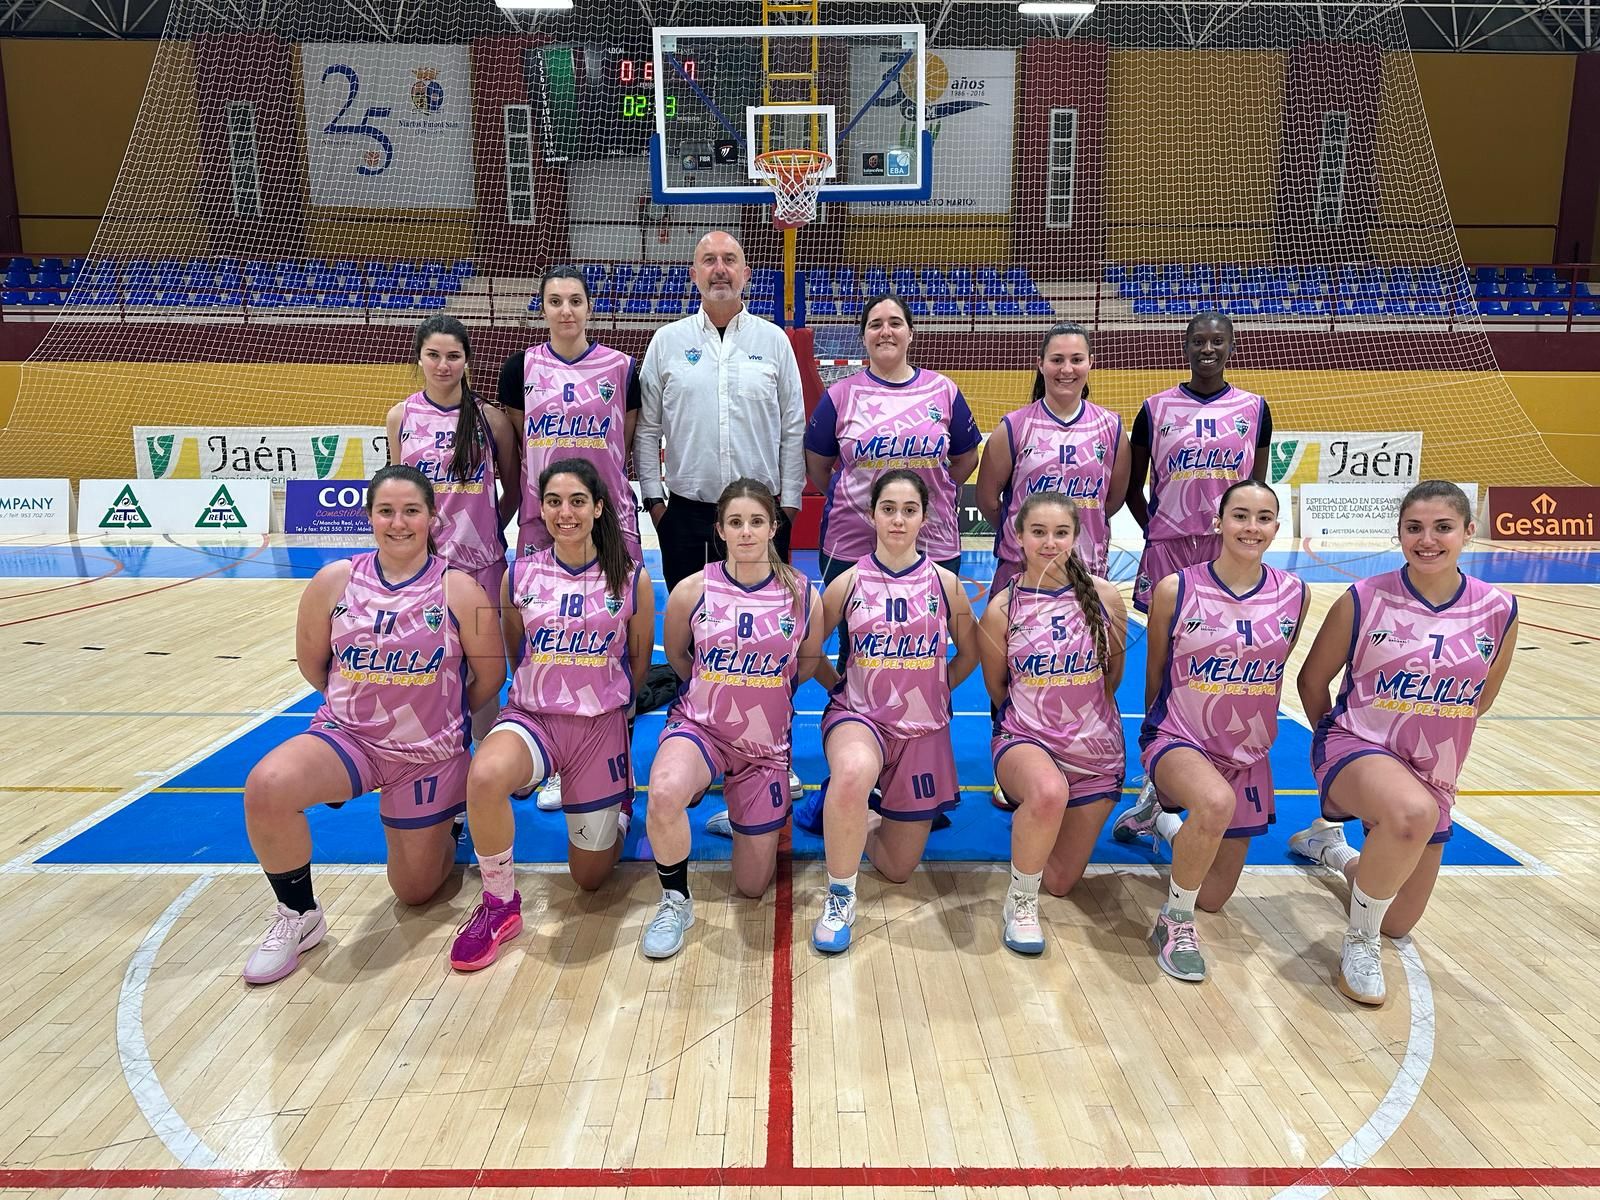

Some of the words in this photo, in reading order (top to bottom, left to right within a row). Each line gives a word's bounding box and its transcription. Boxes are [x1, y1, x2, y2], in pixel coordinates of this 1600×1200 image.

[951, 77, 985, 90] años
[623, 97, 676, 116] 02:3
[905, 105, 937, 120] CM
[320, 64, 393, 176] 25
[889, 167, 905, 175] EBA
[563, 382, 576, 403] 6
[527, 413, 612, 439] MELILLA
[1195, 418, 1217, 438] 14
[434, 430, 456, 449] 23
[854, 435, 946, 460] MELILLA
[207, 435, 297, 472] Jaén
[1058, 444, 1077, 465] 12
[1168, 448, 1245, 473] MELILLA
[1328, 441, 1413, 477] Jaén
[1026, 474, 1104, 498] MELILLA
[1305, 497, 1358, 505] ESPECIALIDAD
[1495, 512, 1594, 536] Gesami
[558, 593, 585, 618] 18
[885, 597, 908, 623] 10
[373, 609, 400, 635] 17
[737, 612, 755, 639] 8
[1051, 615, 1068, 641] 5
[1235, 620, 1253, 647] 4
[528, 627, 617, 656] MELILLA
[853, 631, 941, 659] MELILLA
[1428, 633, 1446, 660] 7
[334, 642, 447, 674] MELILLA
[698, 646, 792, 677] MELILLA
[1225, 684, 1247, 695] DEL
[1375, 670, 1487, 706] MELILLA
[1413, 703, 1437, 717] DEL
[607, 752, 628, 783] 18
[413, 775, 439, 806] 17
[768, 781, 784, 808] 8
[911, 772, 936, 800] 10
[1244, 785, 1262, 813] 4
